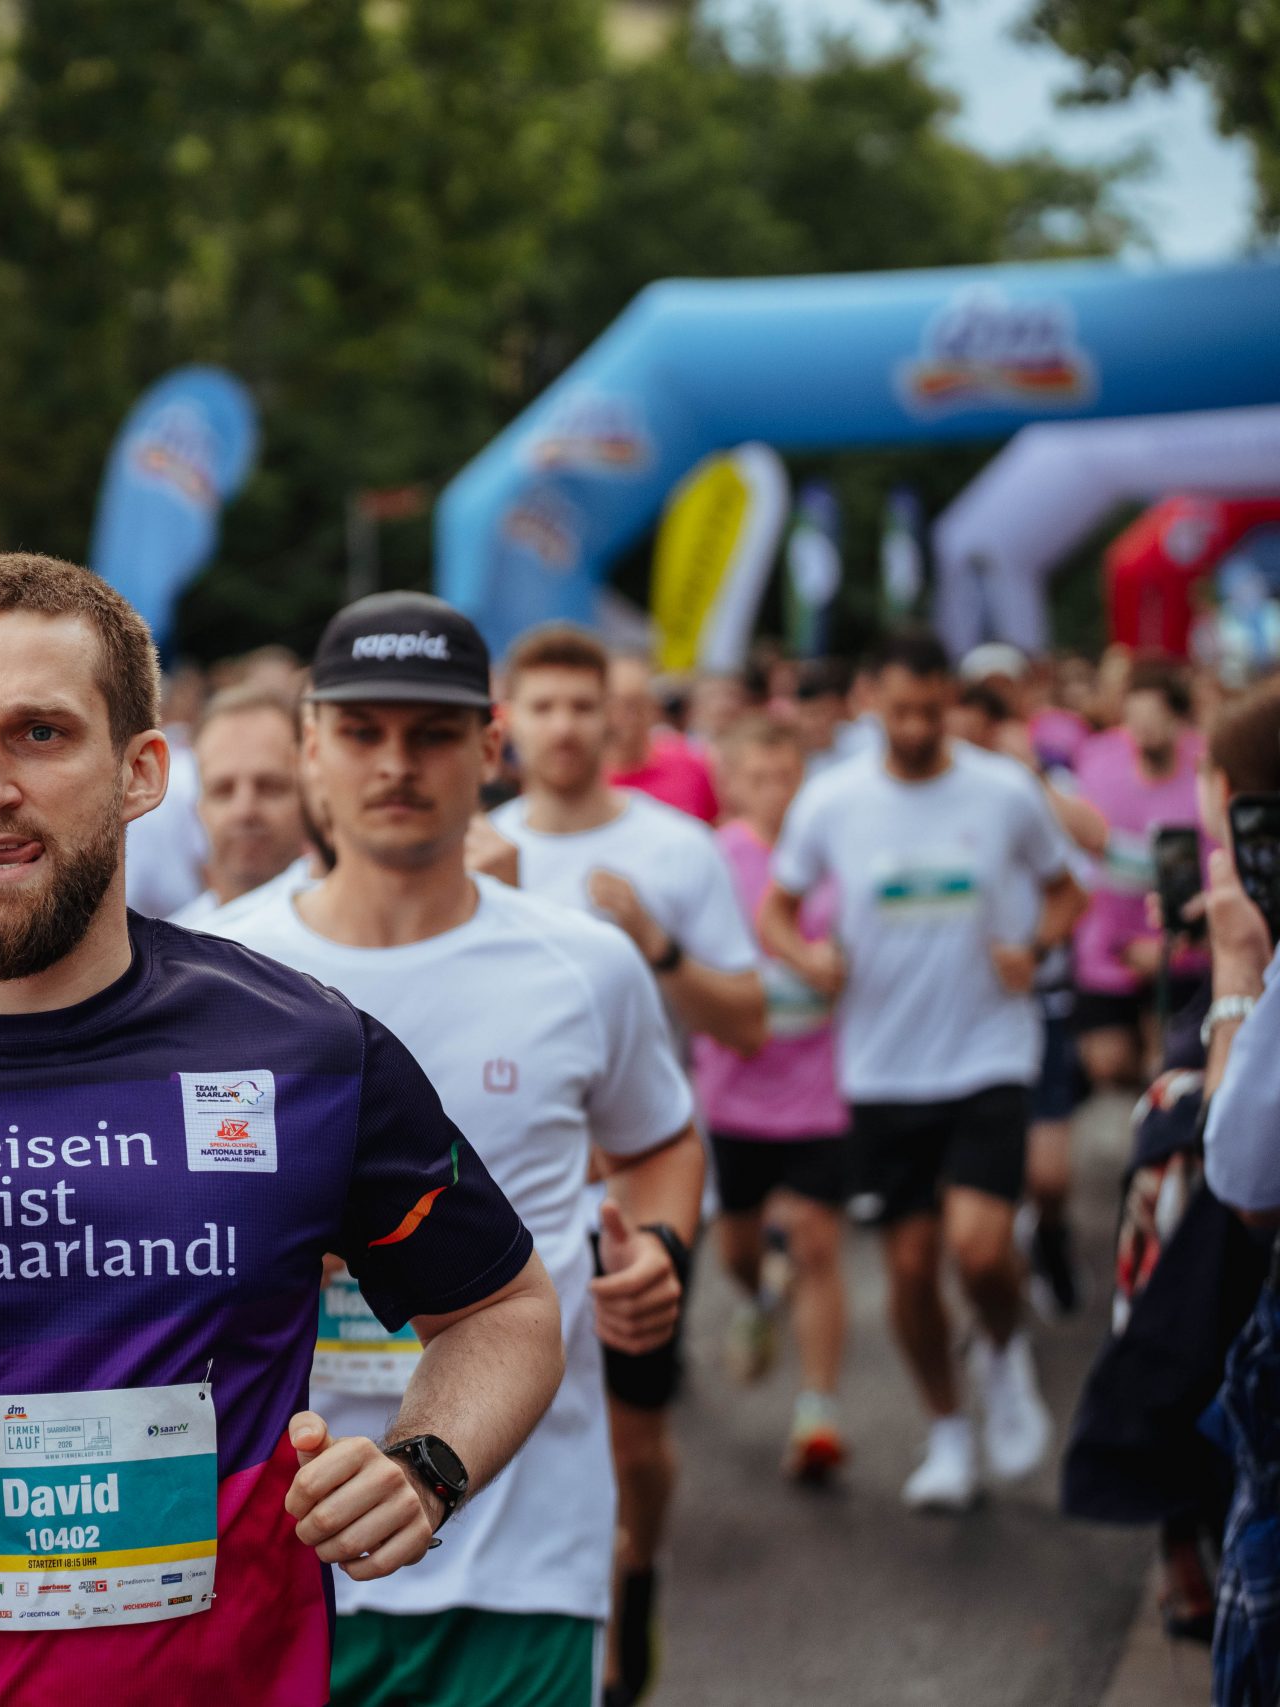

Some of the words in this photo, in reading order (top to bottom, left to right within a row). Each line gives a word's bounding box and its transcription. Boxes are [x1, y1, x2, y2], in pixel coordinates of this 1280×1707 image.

[7, 1404, 25, 1415] dm
[7, 1425, 40, 1435] FIRMEN
[8, 1436, 40, 1450] LAUF
[2, 1472, 120, 1518] David
[25, 1525, 100, 1551] 10402
[28, 1558, 62, 1569] STARTZEIT
[64, 1558, 80, 1568] 18:15
[82, 1557, 97, 1567] UHR
[168, 1595, 192, 1604] FORUM
[123, 1601, 162, 1611] WOCHENSPIEGEL
